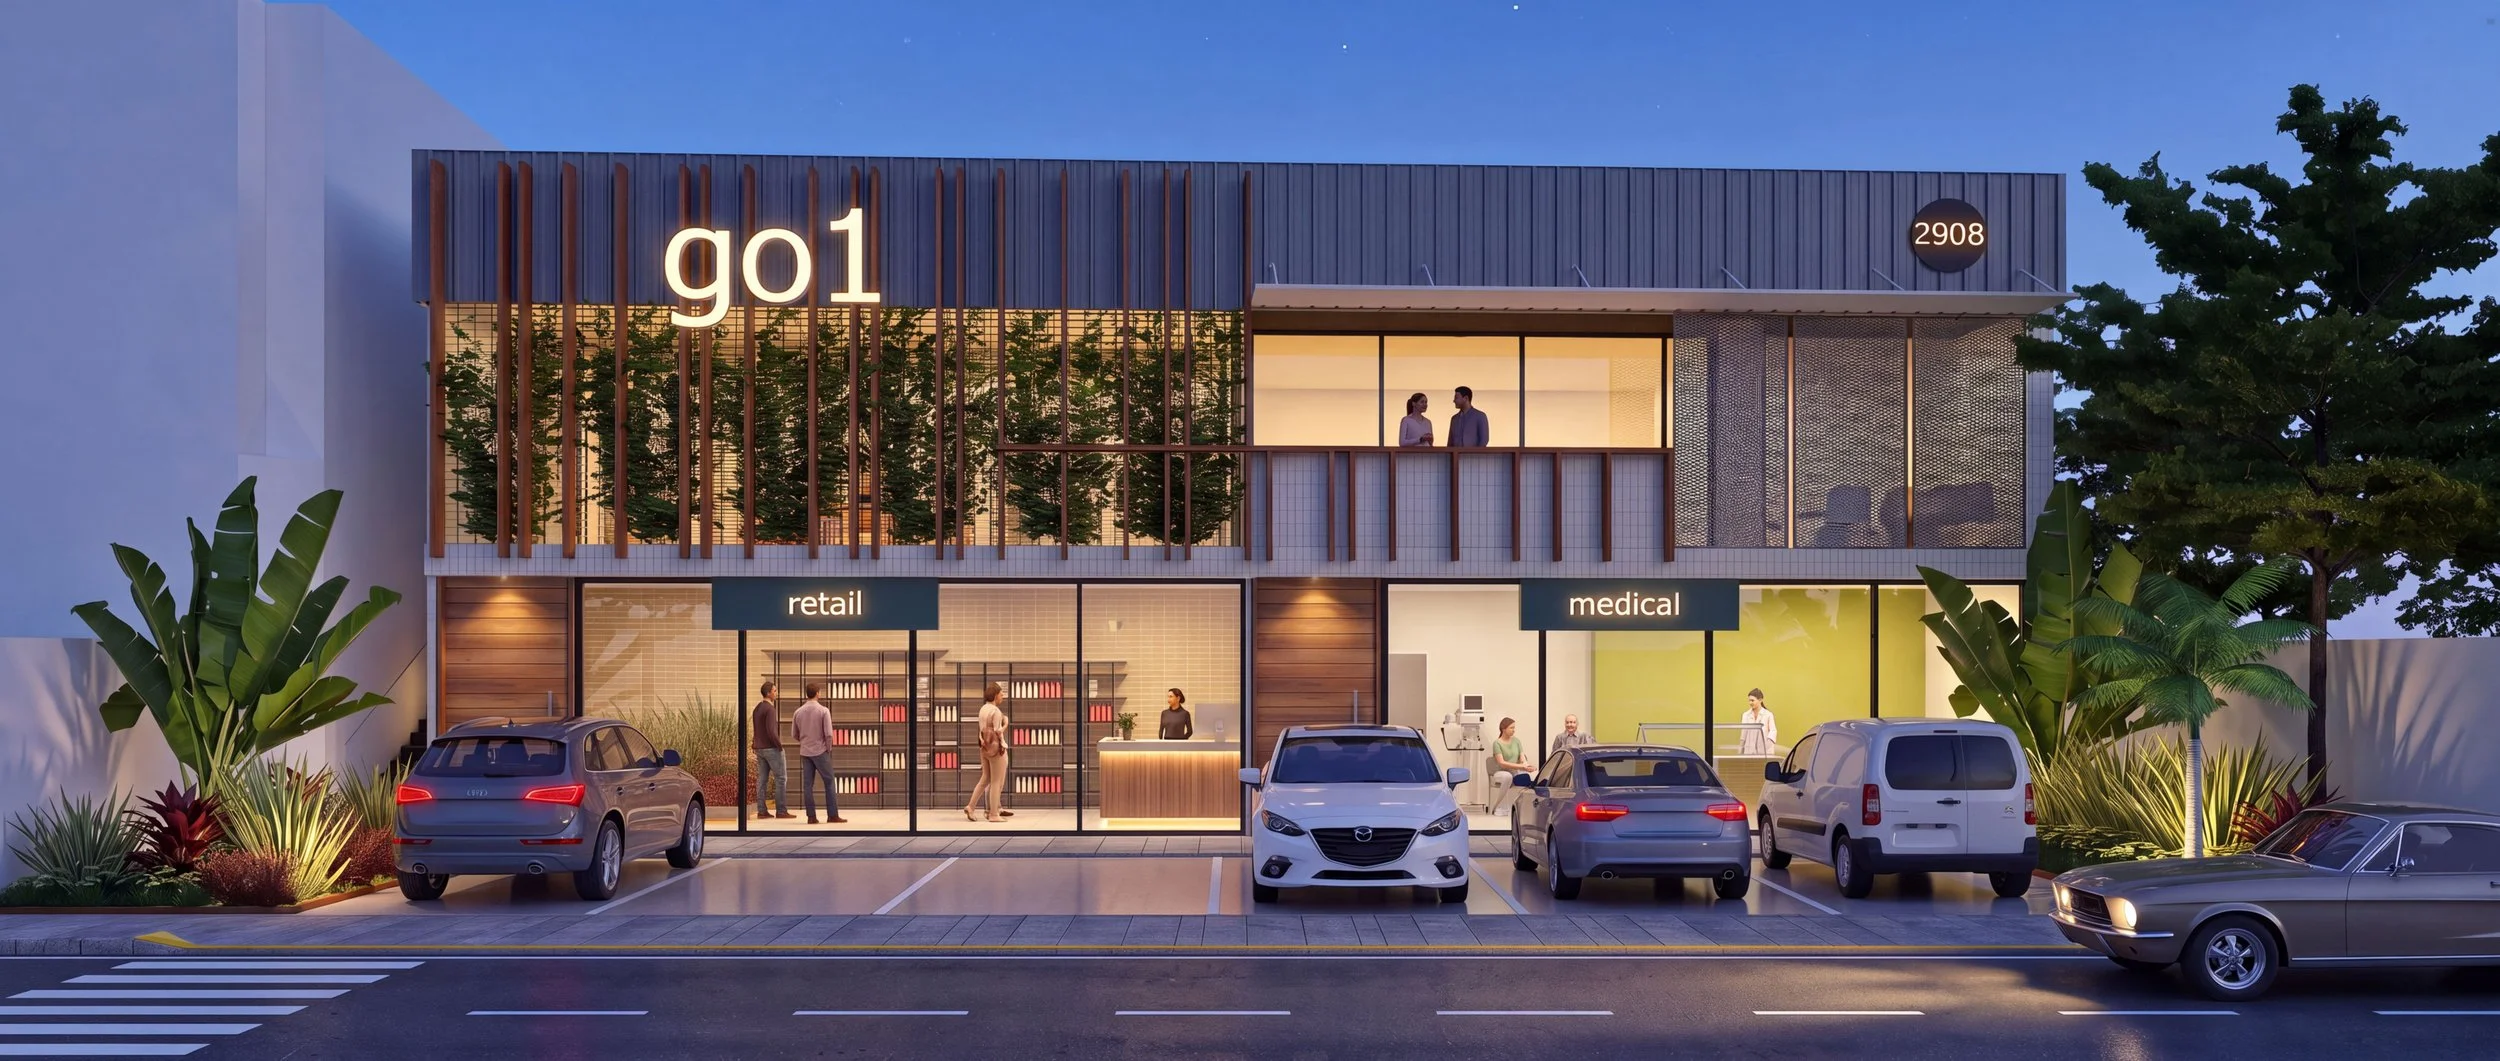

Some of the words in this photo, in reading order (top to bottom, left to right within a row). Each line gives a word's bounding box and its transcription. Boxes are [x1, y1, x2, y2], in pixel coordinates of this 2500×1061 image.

[1915, 222, 1985, 246] 2908
[664, 207, 881, 328] go1
[788, 590, 862, 616] retail
[1569, 591, 1680, 616] medical
